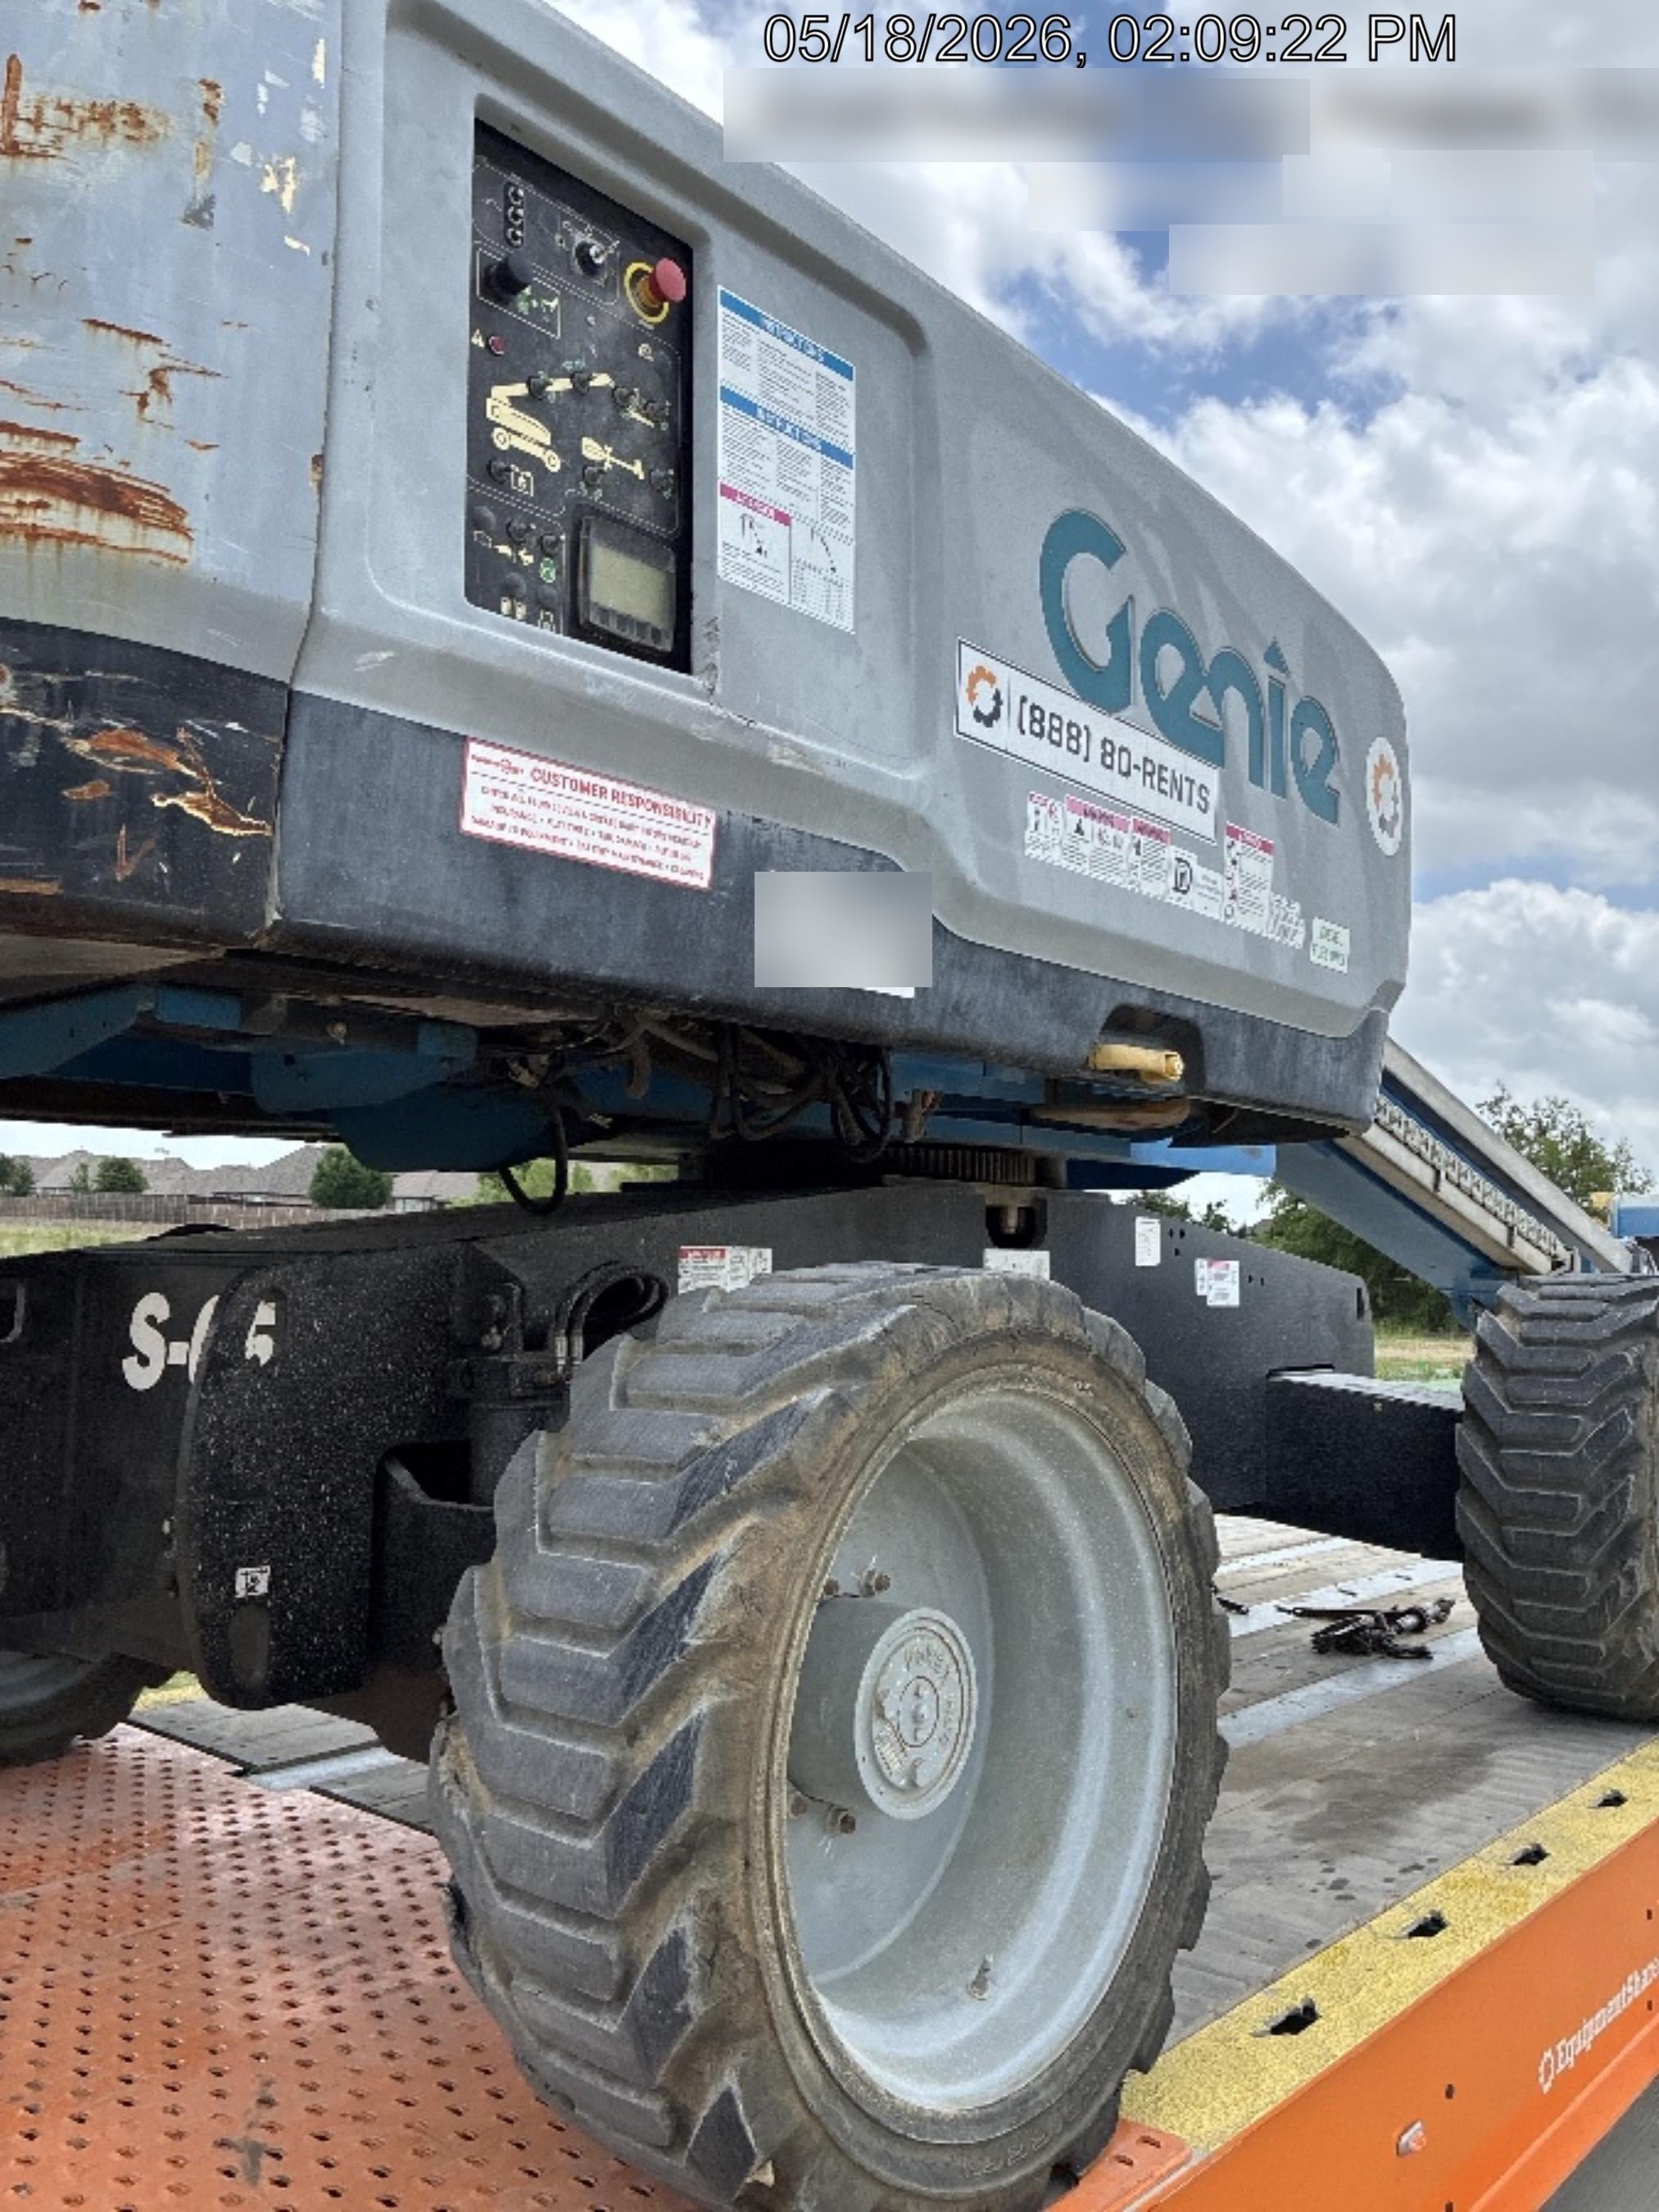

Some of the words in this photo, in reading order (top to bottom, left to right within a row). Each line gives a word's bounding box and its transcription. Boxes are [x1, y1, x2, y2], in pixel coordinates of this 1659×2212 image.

[1039, 508, 1340, 824] Genie
[530, 767, 608, 800] CUSTOMER
[610, 786, 712, 829] RESPONSIBILITY
[1100, 737, 1210, 815] 80-RENTS
